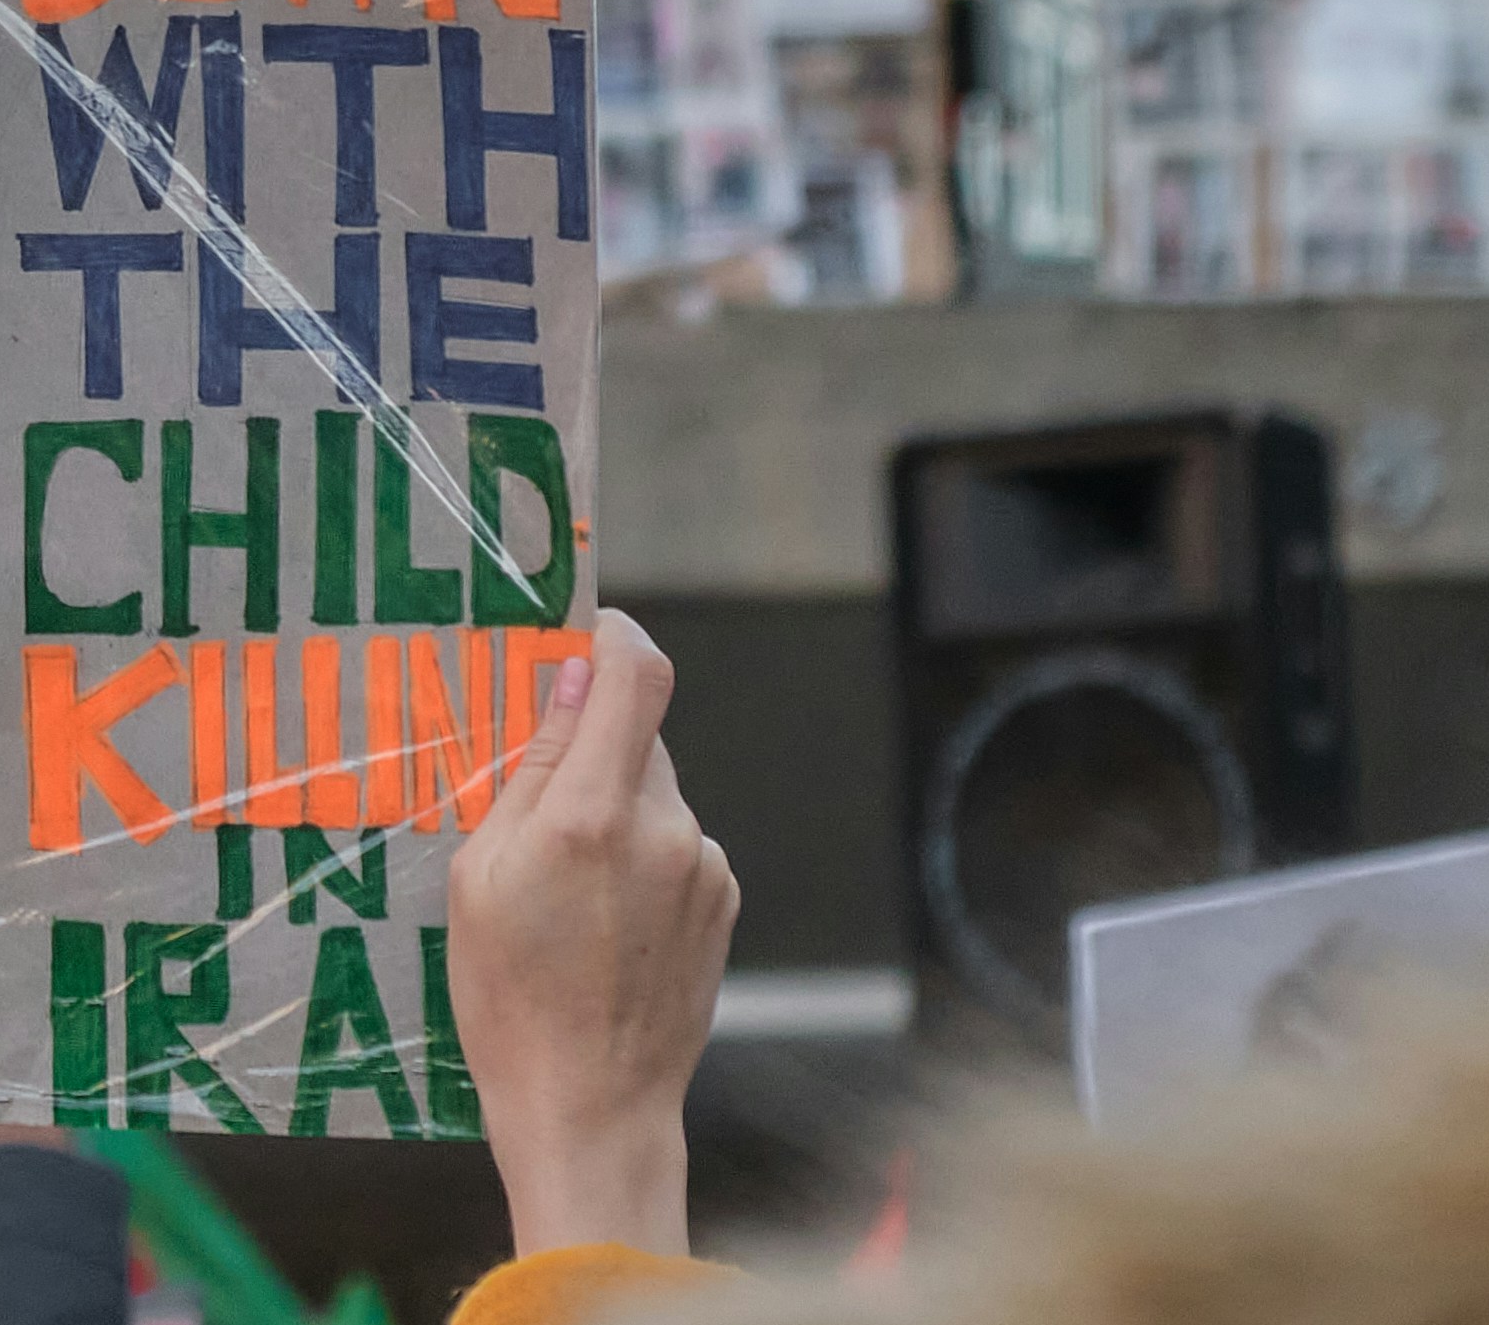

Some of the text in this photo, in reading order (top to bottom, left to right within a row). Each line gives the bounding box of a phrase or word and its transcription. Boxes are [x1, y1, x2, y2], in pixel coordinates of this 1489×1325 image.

[36, 12, 590, 241] WITH
[16, 231, 545, 411] THE
[24, 409, 575, 636] CHILD
[216, 823, 388, 924] IN
